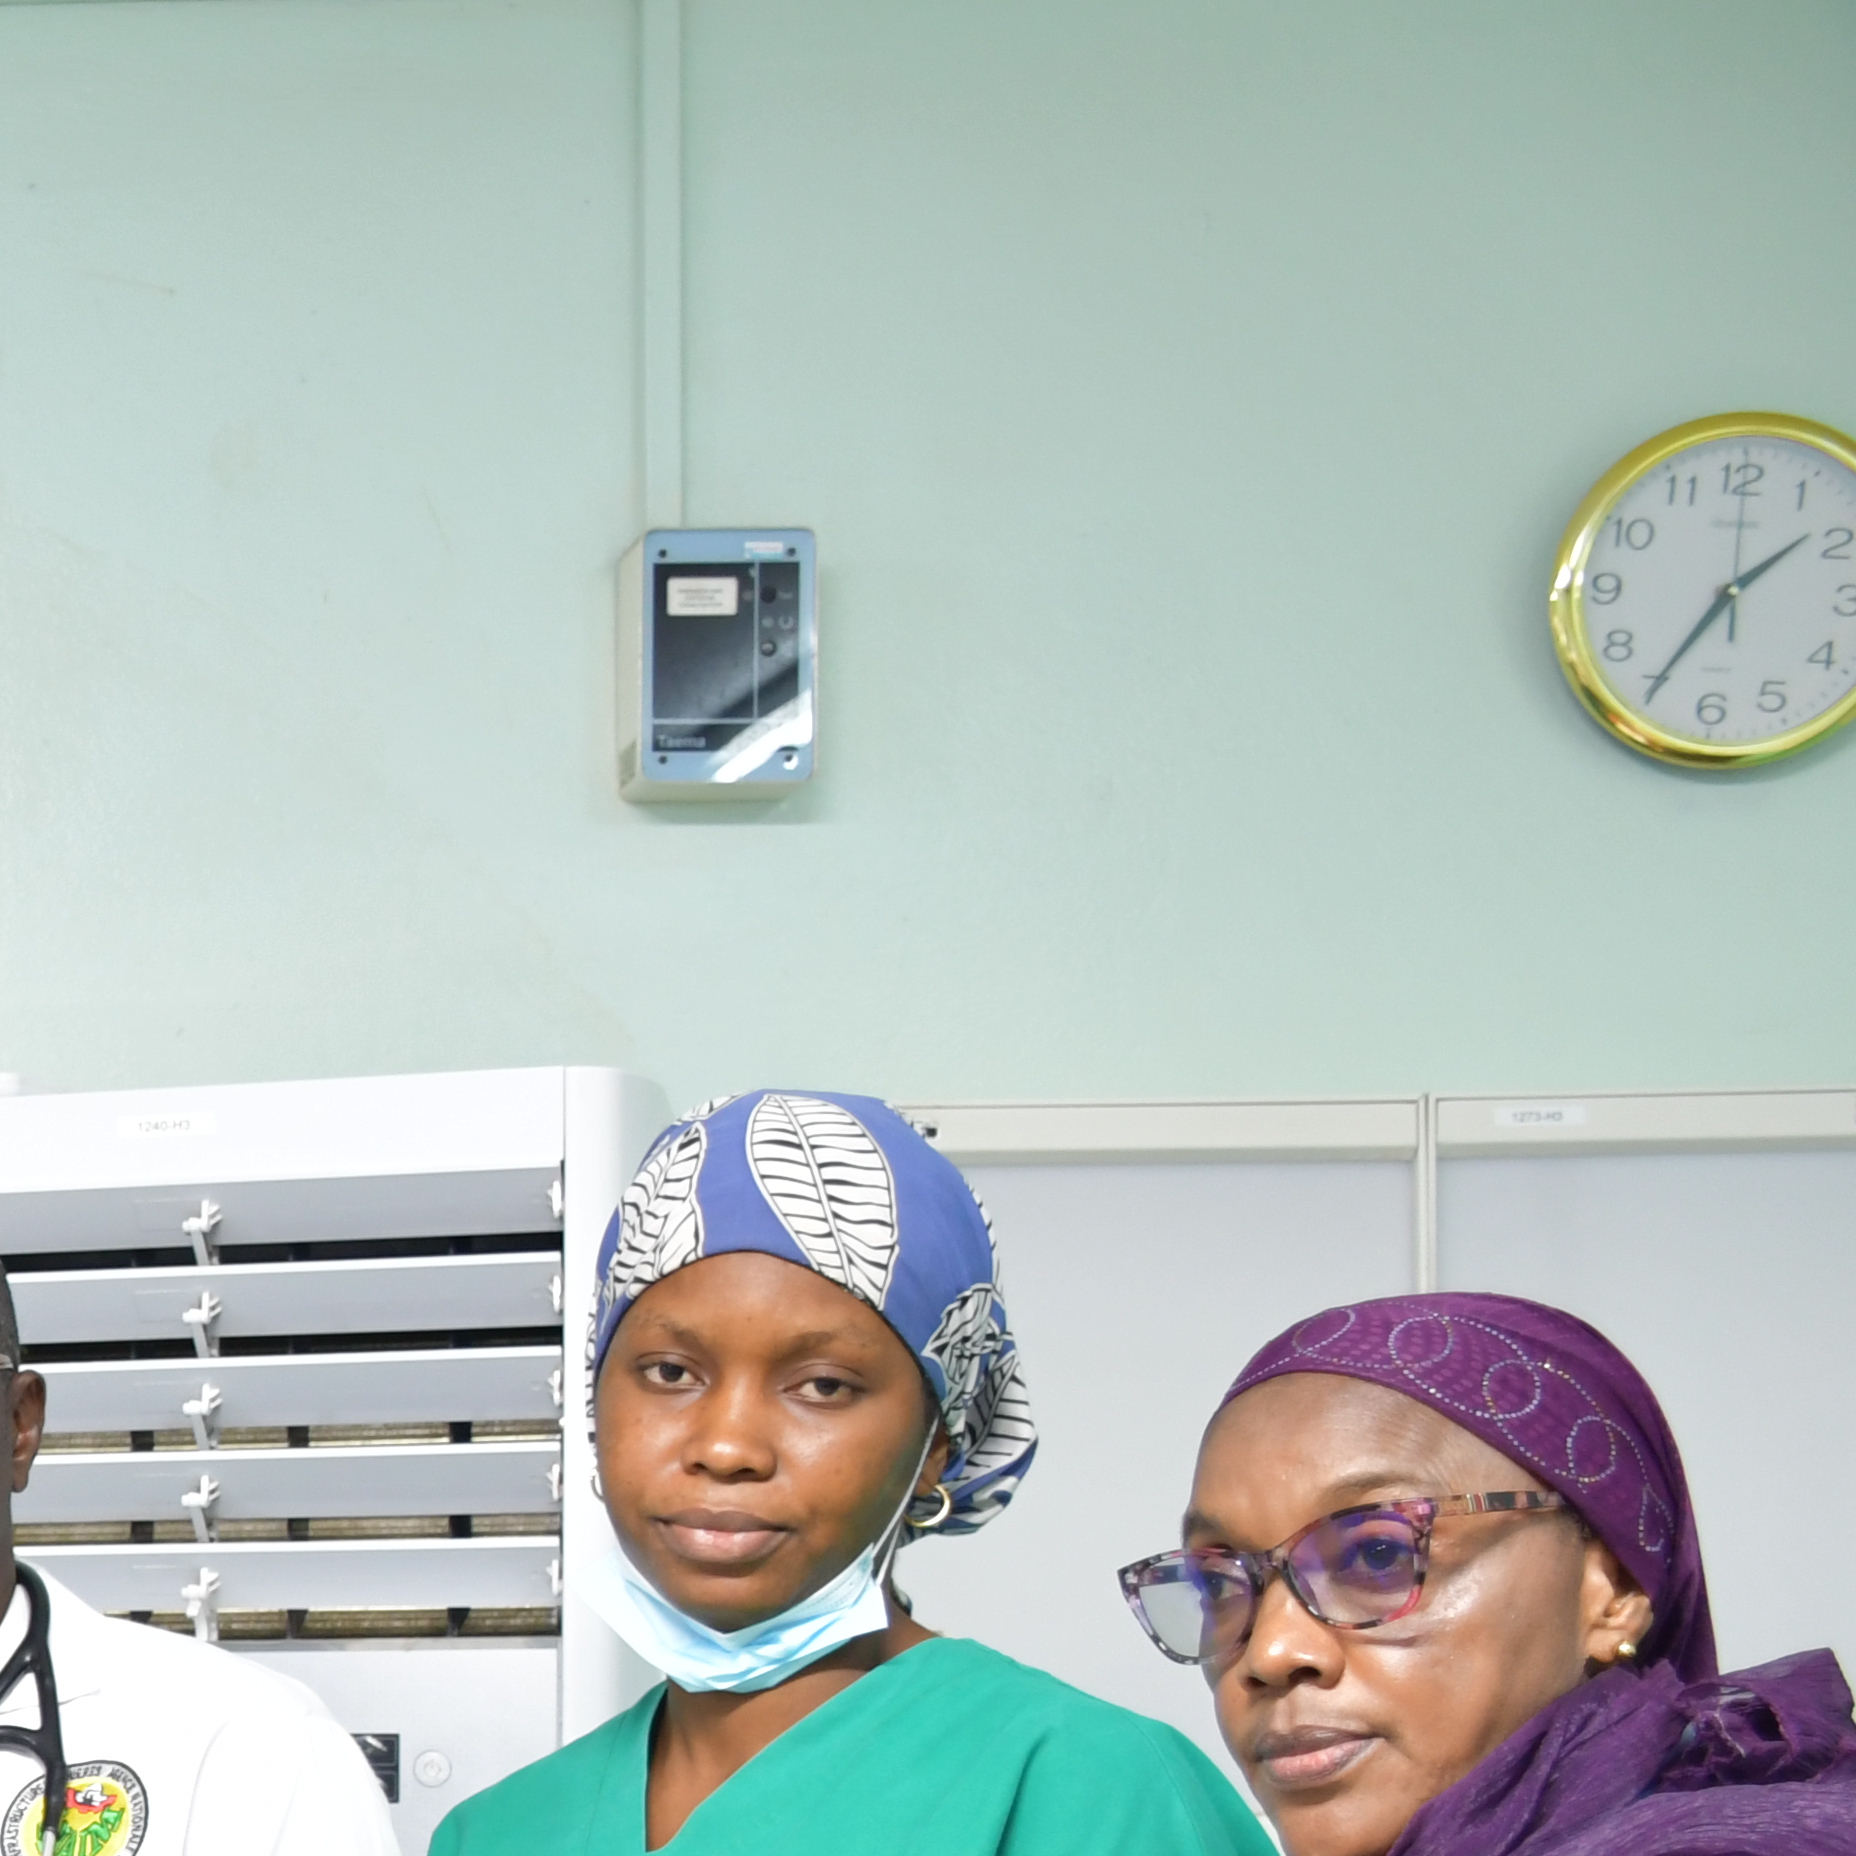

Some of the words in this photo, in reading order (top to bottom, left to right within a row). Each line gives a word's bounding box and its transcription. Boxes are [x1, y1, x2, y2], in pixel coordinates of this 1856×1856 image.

[1665, 475, 1698, 506] 11
[1720, 463, 1765, 496] 12
[1796, 479, 1807, 512] 1
[1614, 518, 1655, 550] 10
[1820, 527, 1855, 560] 2
[1591, 573, 1623, 605] 9
[1603, 629, 1634, 662] 8
[1807, 640, 1835, 671] 4
[1696, 693, 1727, 726] 6
[1757, 680, 1787, 712] 5
